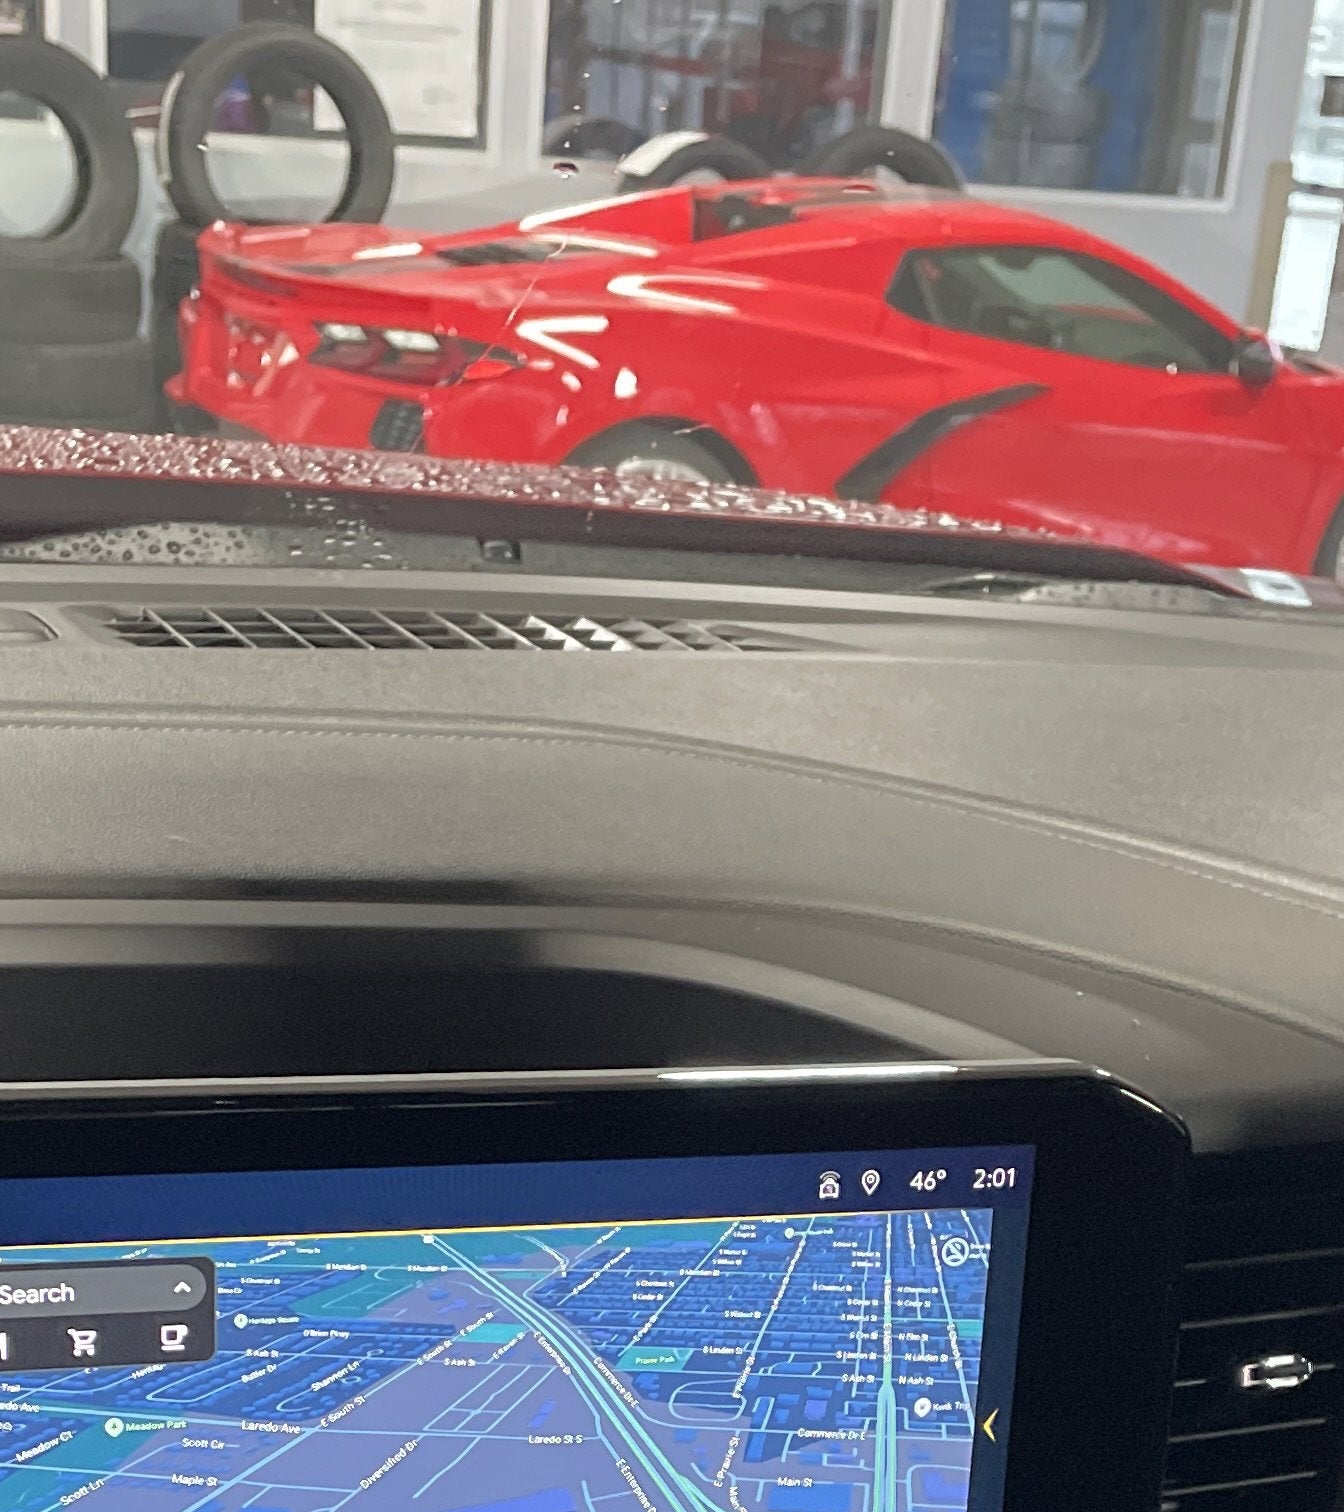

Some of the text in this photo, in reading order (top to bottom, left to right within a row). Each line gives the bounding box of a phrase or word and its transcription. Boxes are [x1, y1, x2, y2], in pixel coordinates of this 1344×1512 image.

[910, 1169, 947, 1190] 46°
[973, 1168, 1015, 1189] 2:01
[907, 1376, 924, 1384] Ash
[19, 1402, 41, 1413] Ave
[327, 1403, 355, 1423] South
[354, 1396, 366, 1408] St
[126, 1420, 187, 1431] Meadow Park
[241, 1420, 301, 1435] Laredo Ave
[528, 1434, 561, 1444] Laredo
[797, 1428, 846, 1439] Commerce
[15, 1437, 60, 1463] Meadow
[181, 1437, 208, 1449] Scott
[359, 1439, 418, 1490] Diversified Dr
[171, 1473, 218, 1487] Maple St
[620, 1463, 652, 1509] Enterprise
[777, 1477, 813, 1487] Main St
[60, 1478, 105, 1506] Scott Ln
